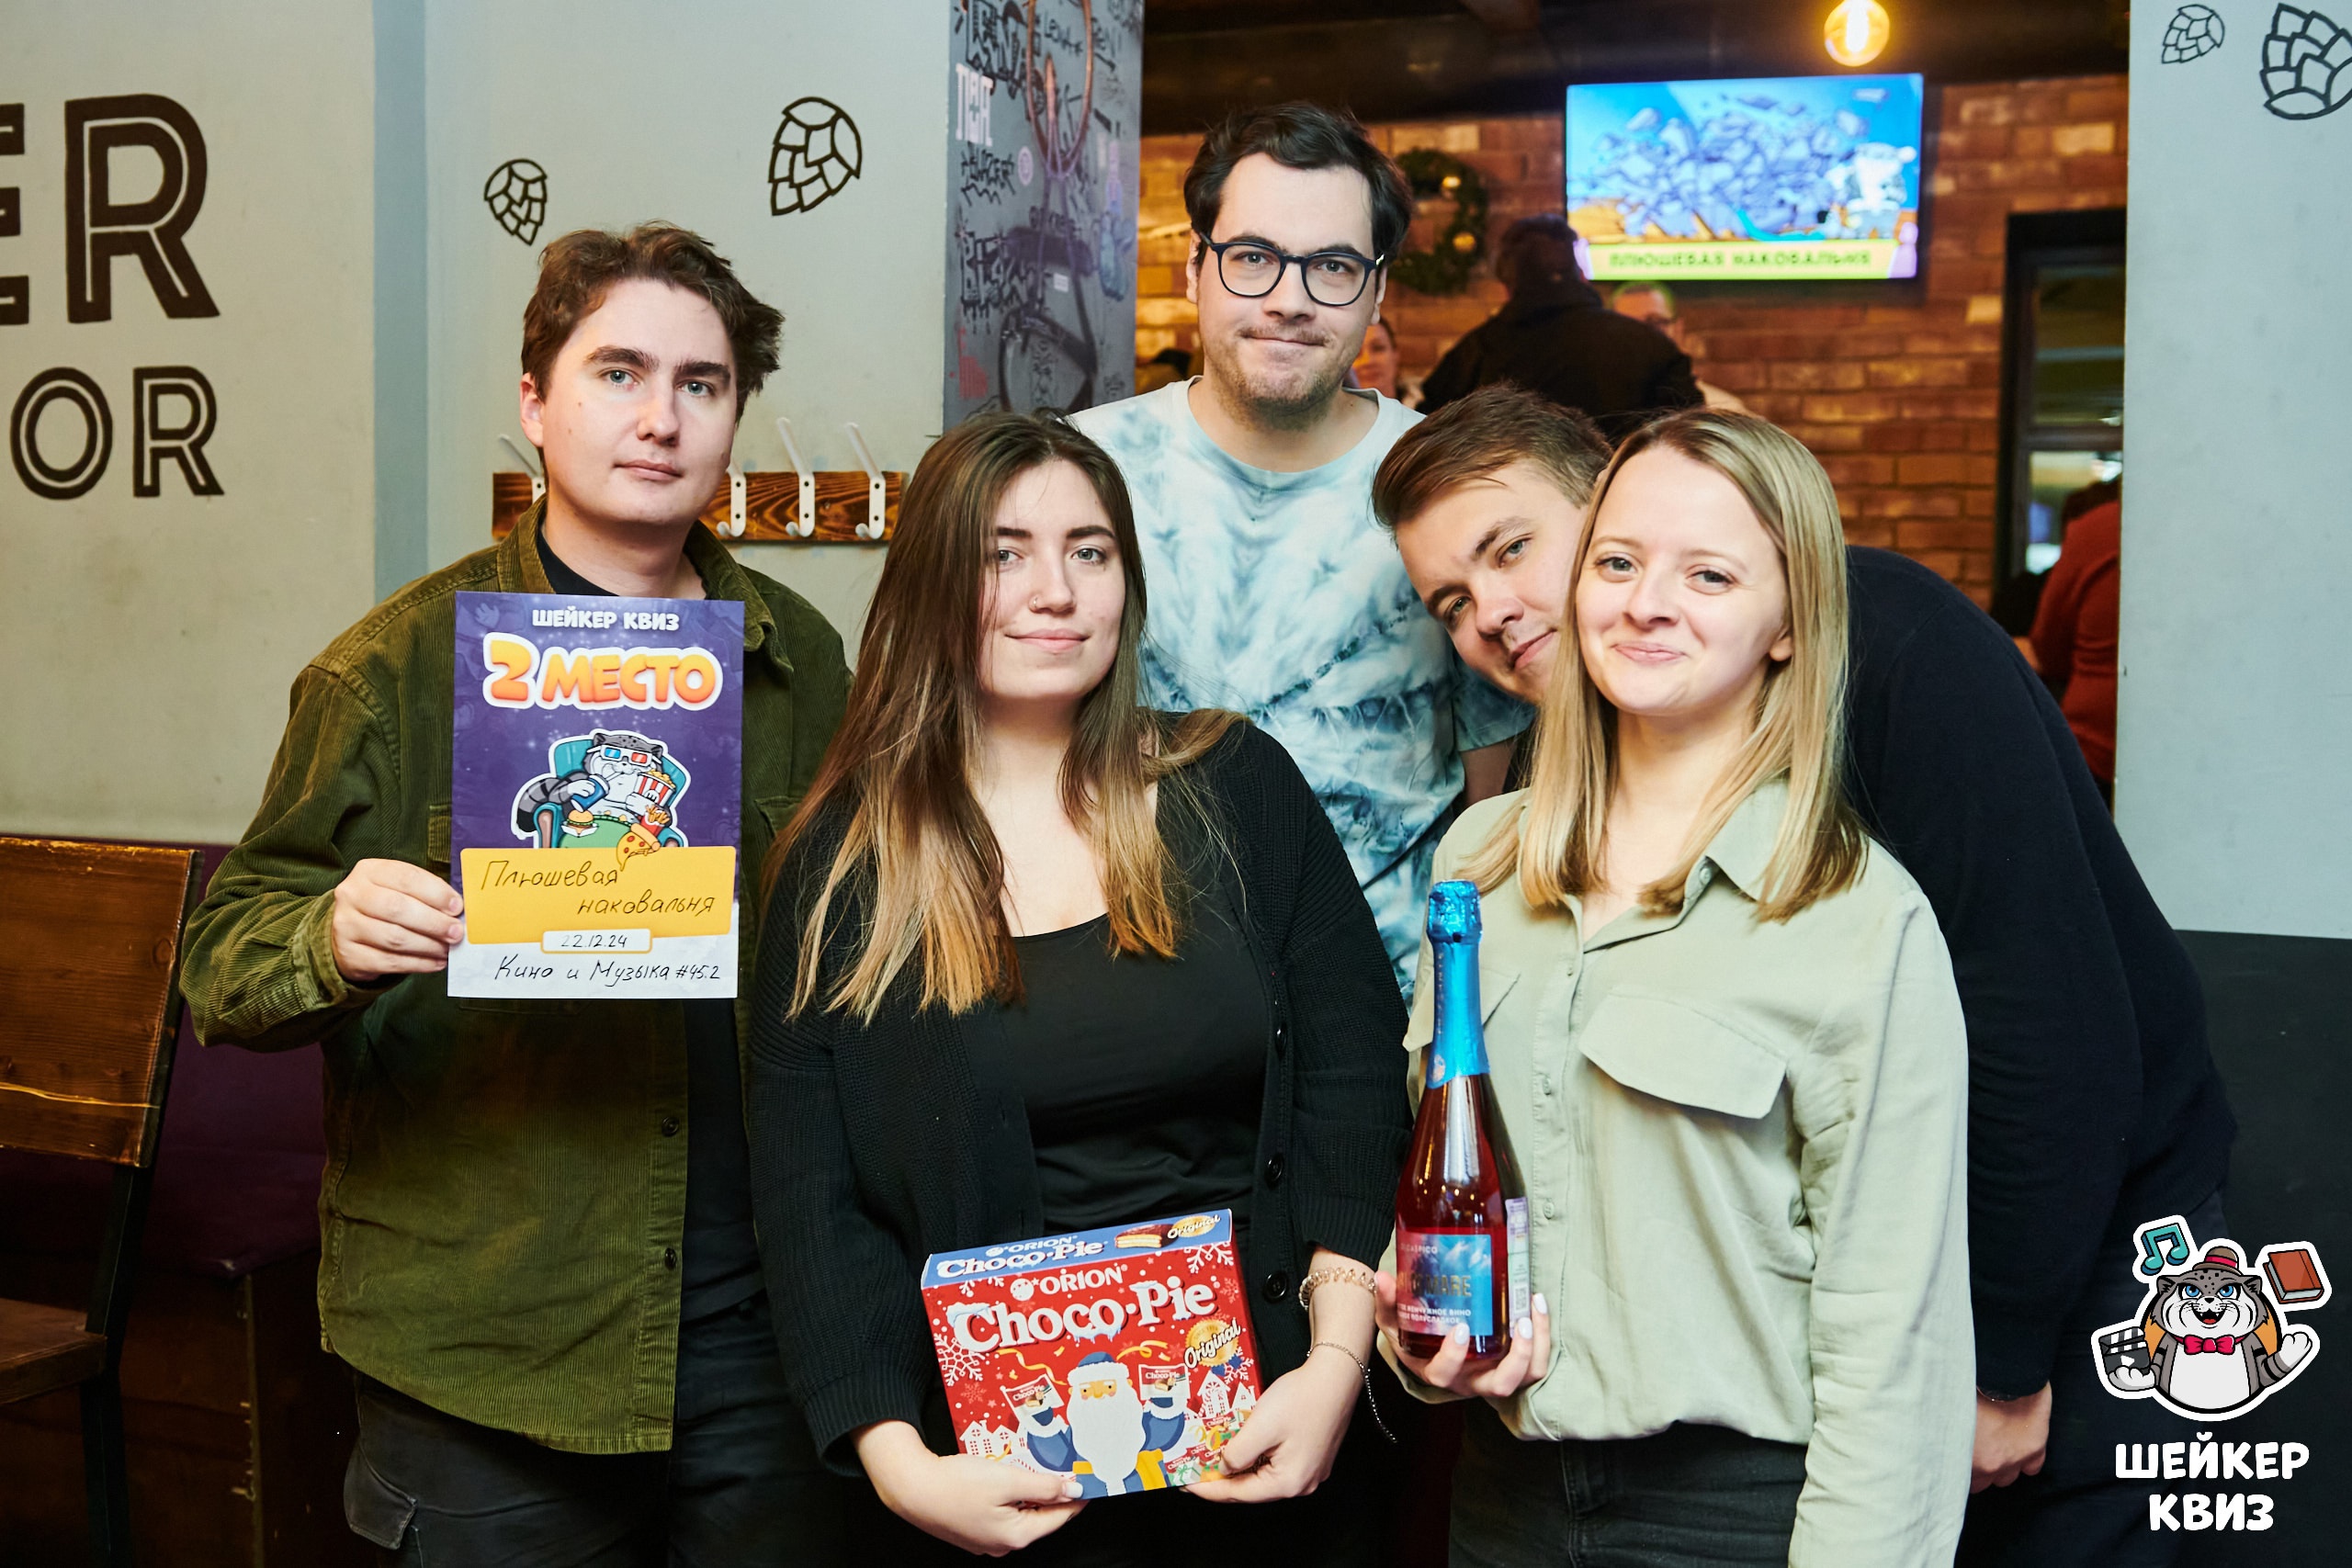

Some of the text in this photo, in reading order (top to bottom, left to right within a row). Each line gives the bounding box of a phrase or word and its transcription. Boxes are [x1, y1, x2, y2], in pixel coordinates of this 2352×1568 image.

[532, 608, 681, 632] ШЕЙКЕР КВИЗ
[487, 636, 719, 706] 2 МЕСТО
[481, 859, 619, 890] Плюшевая
[576, 891, 716, 918] наковальня
[560, 934, 628, 949] 22.12.24
[494, 953, 721, 987] Кино и Музыка #45.2
[1167, 1214, 1222, 1239] Original
[1008, 1235, 1074, 1253] ORION
[1037, 1265, 1123, 1296] ORION
[1183, 1317, 1241, 1369] Original
